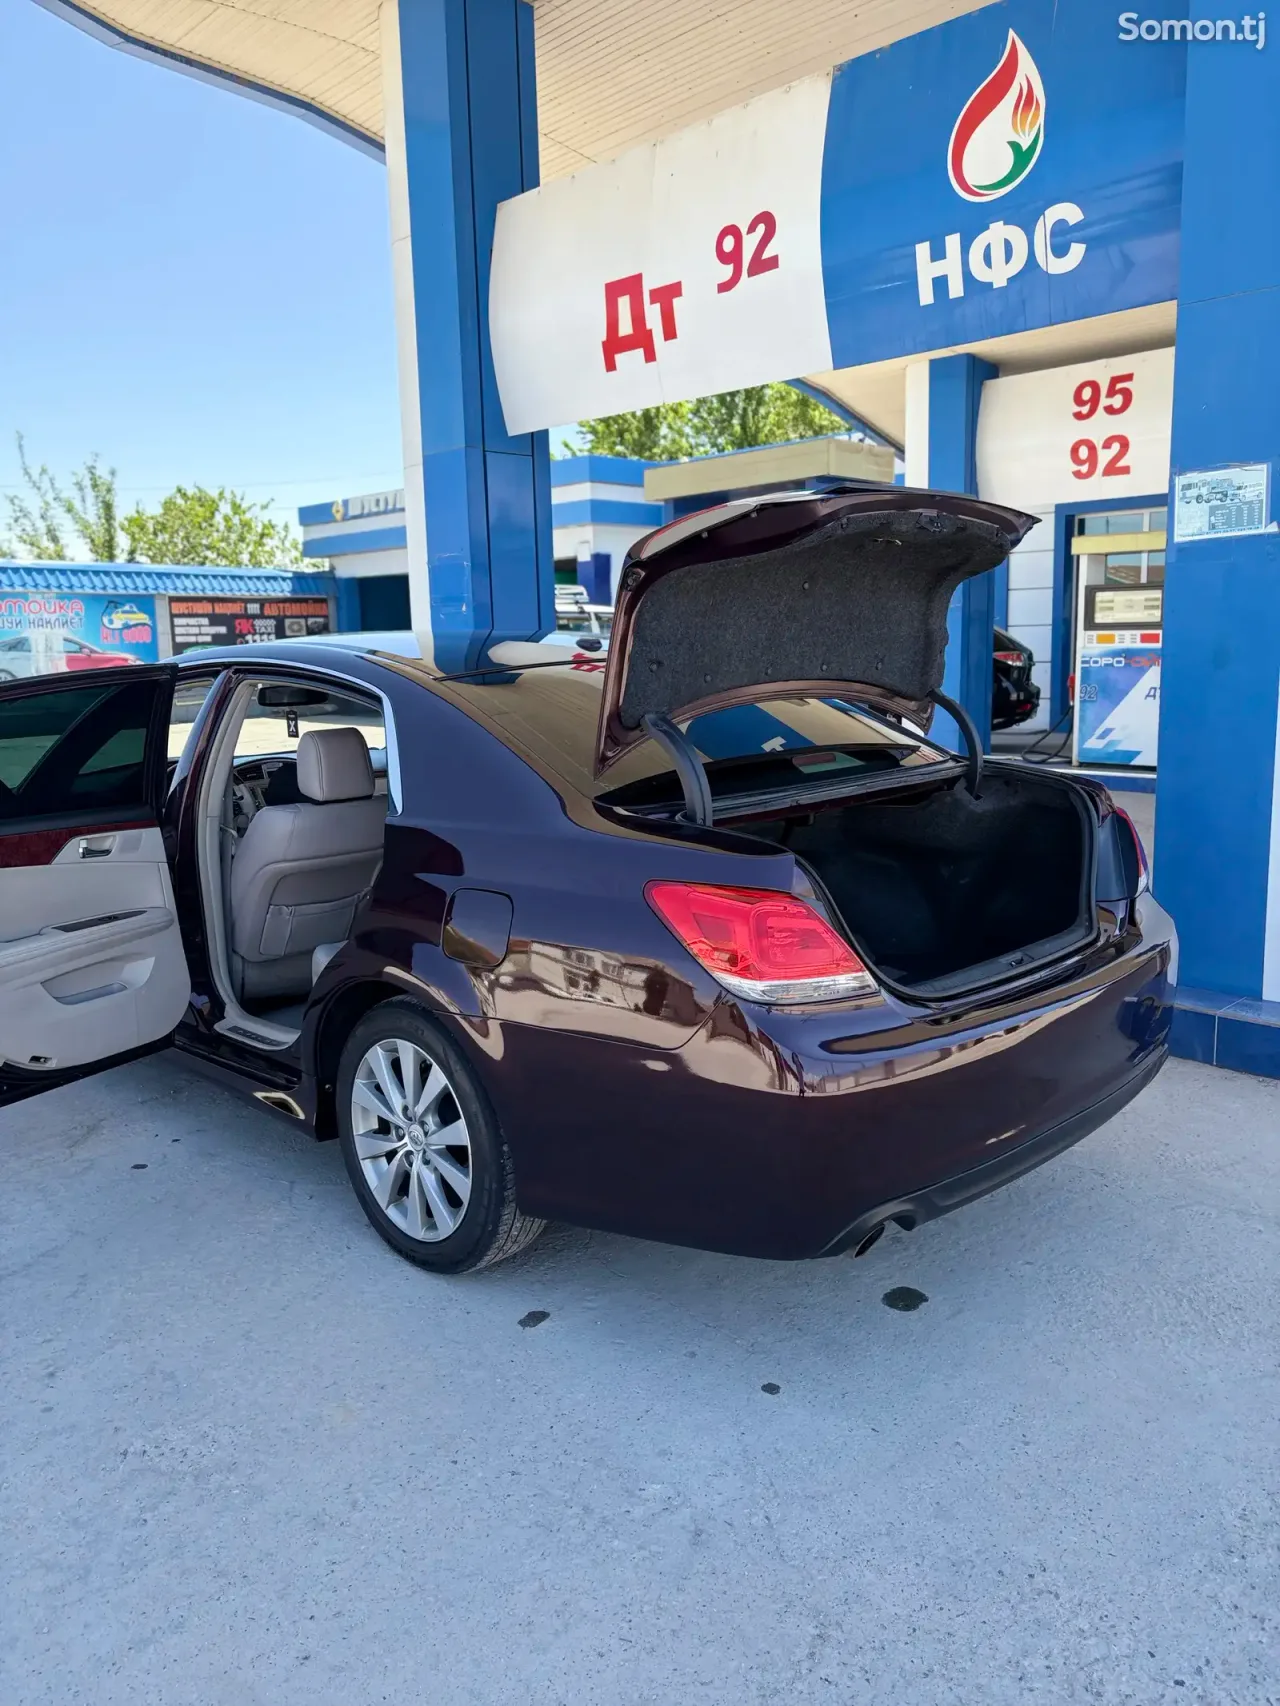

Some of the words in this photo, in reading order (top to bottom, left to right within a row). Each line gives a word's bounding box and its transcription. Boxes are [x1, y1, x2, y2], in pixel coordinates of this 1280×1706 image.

[715, 210, 779, 294] 92
[915, 202, 1087, 307] НФС
[1072, 372, 1134, 422] 95
[1070, 434, 1131, 480] 92
[1080, 684, 1098, 701] 92
[1144, 686, 1161, 700] Д
